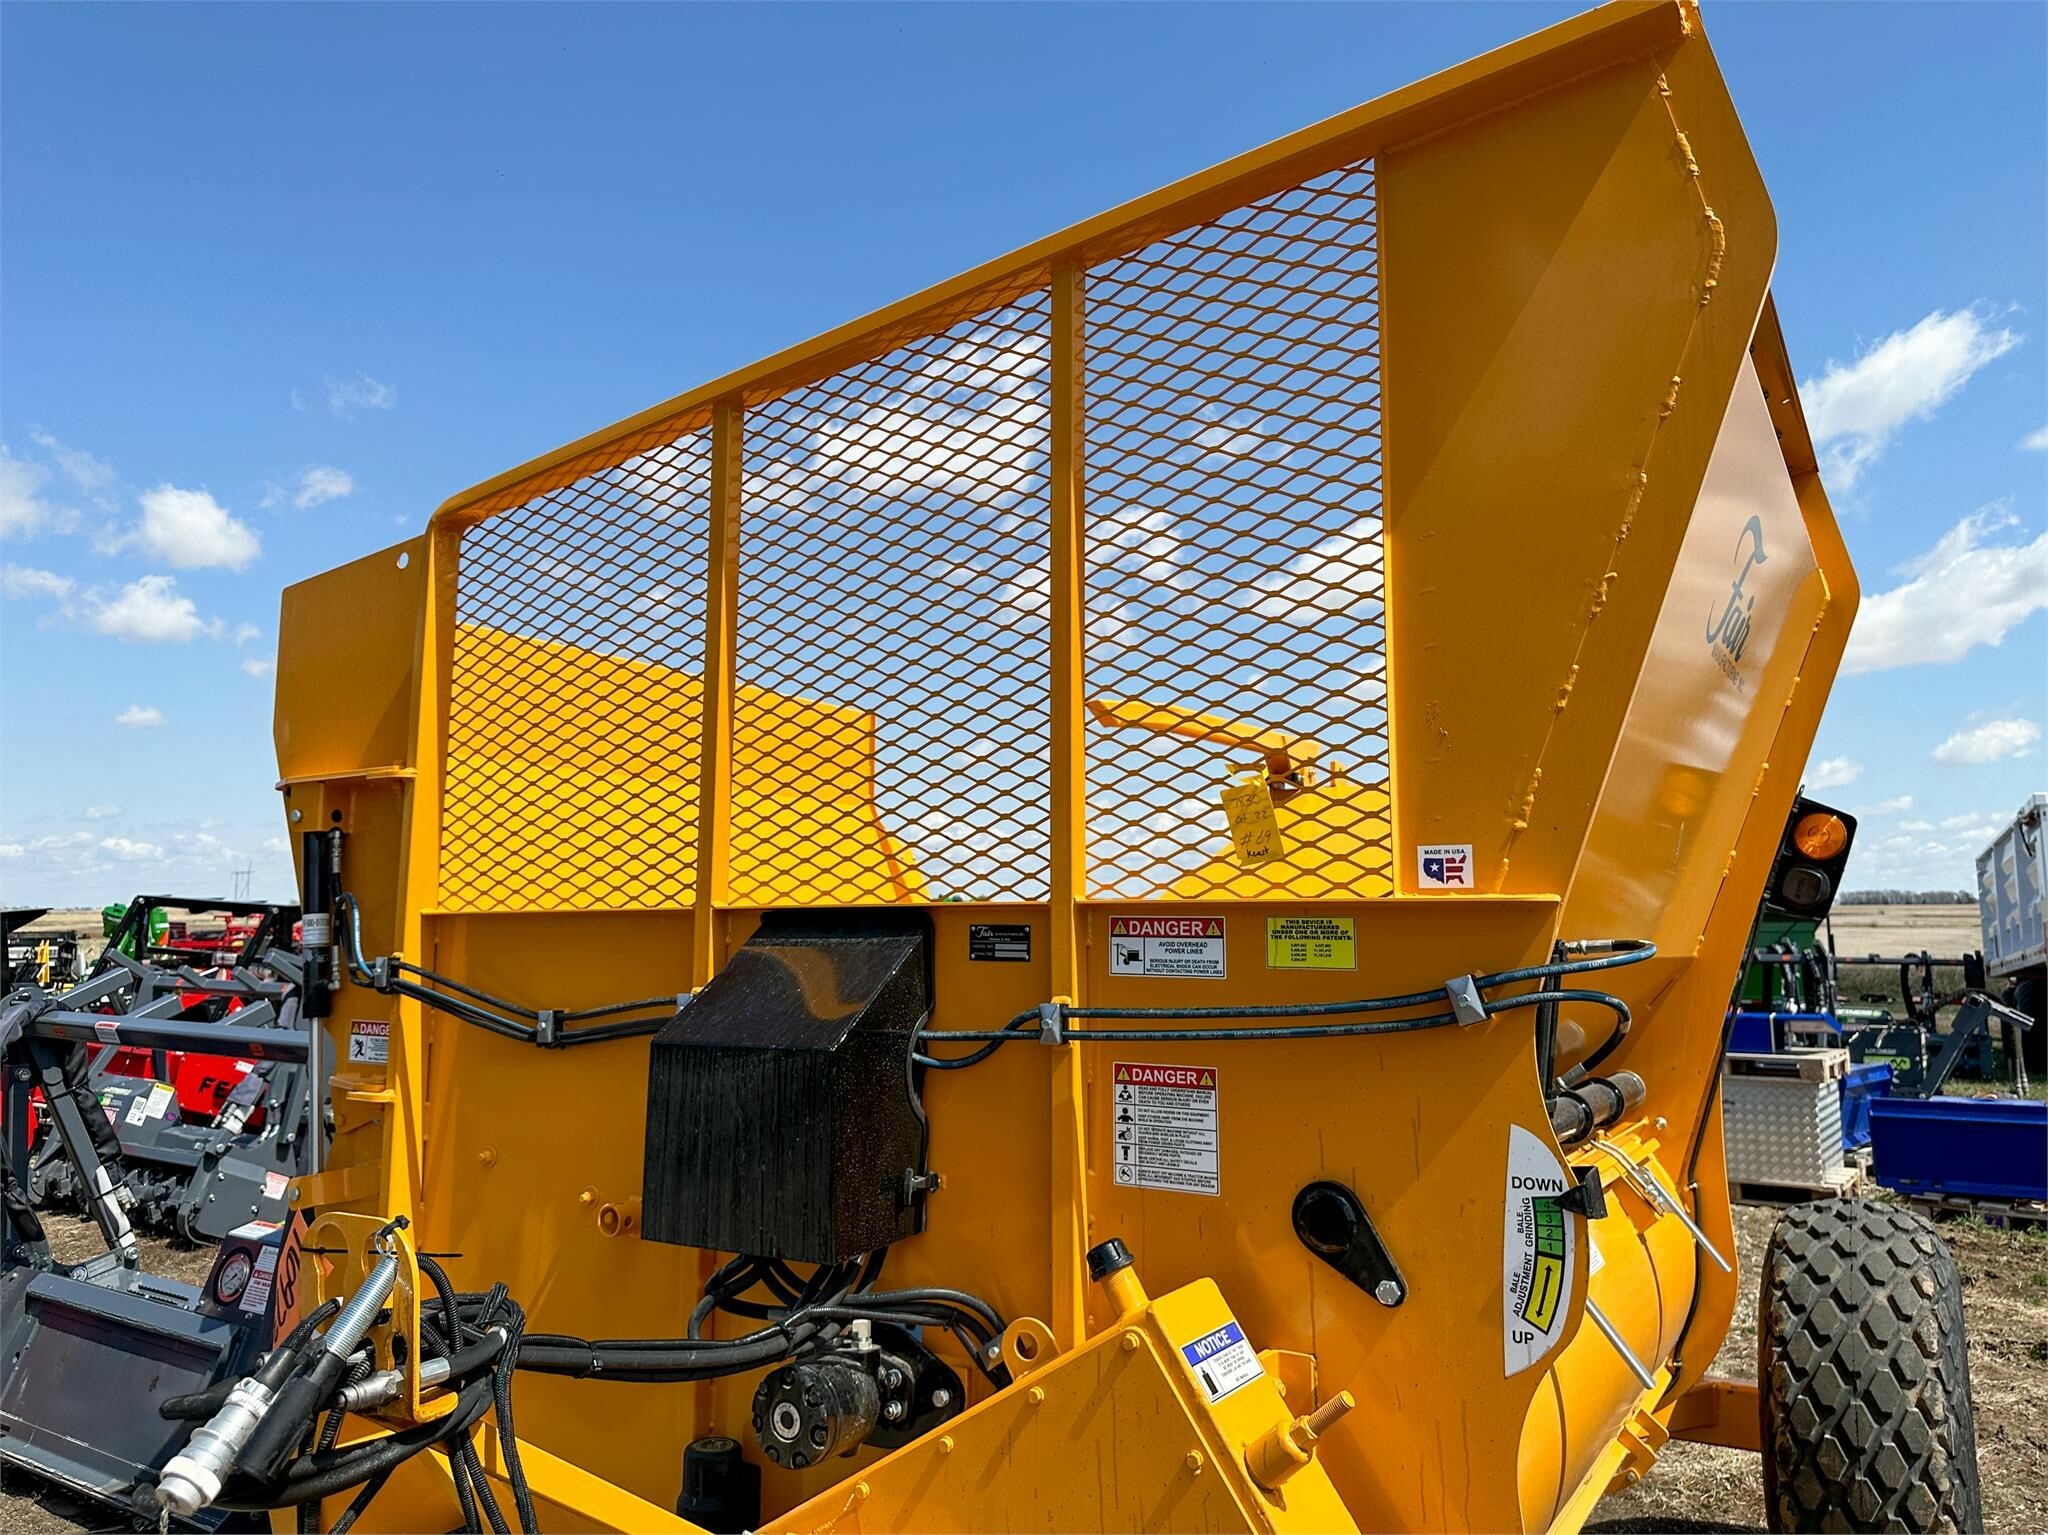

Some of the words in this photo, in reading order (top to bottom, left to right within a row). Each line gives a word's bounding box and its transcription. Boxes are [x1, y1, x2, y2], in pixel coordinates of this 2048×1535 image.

[1129, 920, 1204, 936] DANGER
[1132, 1068, 1198, 1085] DANGER
[1511, 1176, 1563, 1192] DOWN
[1522, 1197, 1534, 1247] GRINDING
[1545, 1214, 1553, 1223] 3
[1546, 1228, 1554, 1238] 2
[1546, 1242, 1553, 1252] 1
[1510, 1271, 1521, 1294] BALE
[1512, 1252, 1533, 1317] ADJUSTMENT
[1194, 1329, 1232, 1359] NOTICE
[1512, 1330, 1535, 1344] UP
